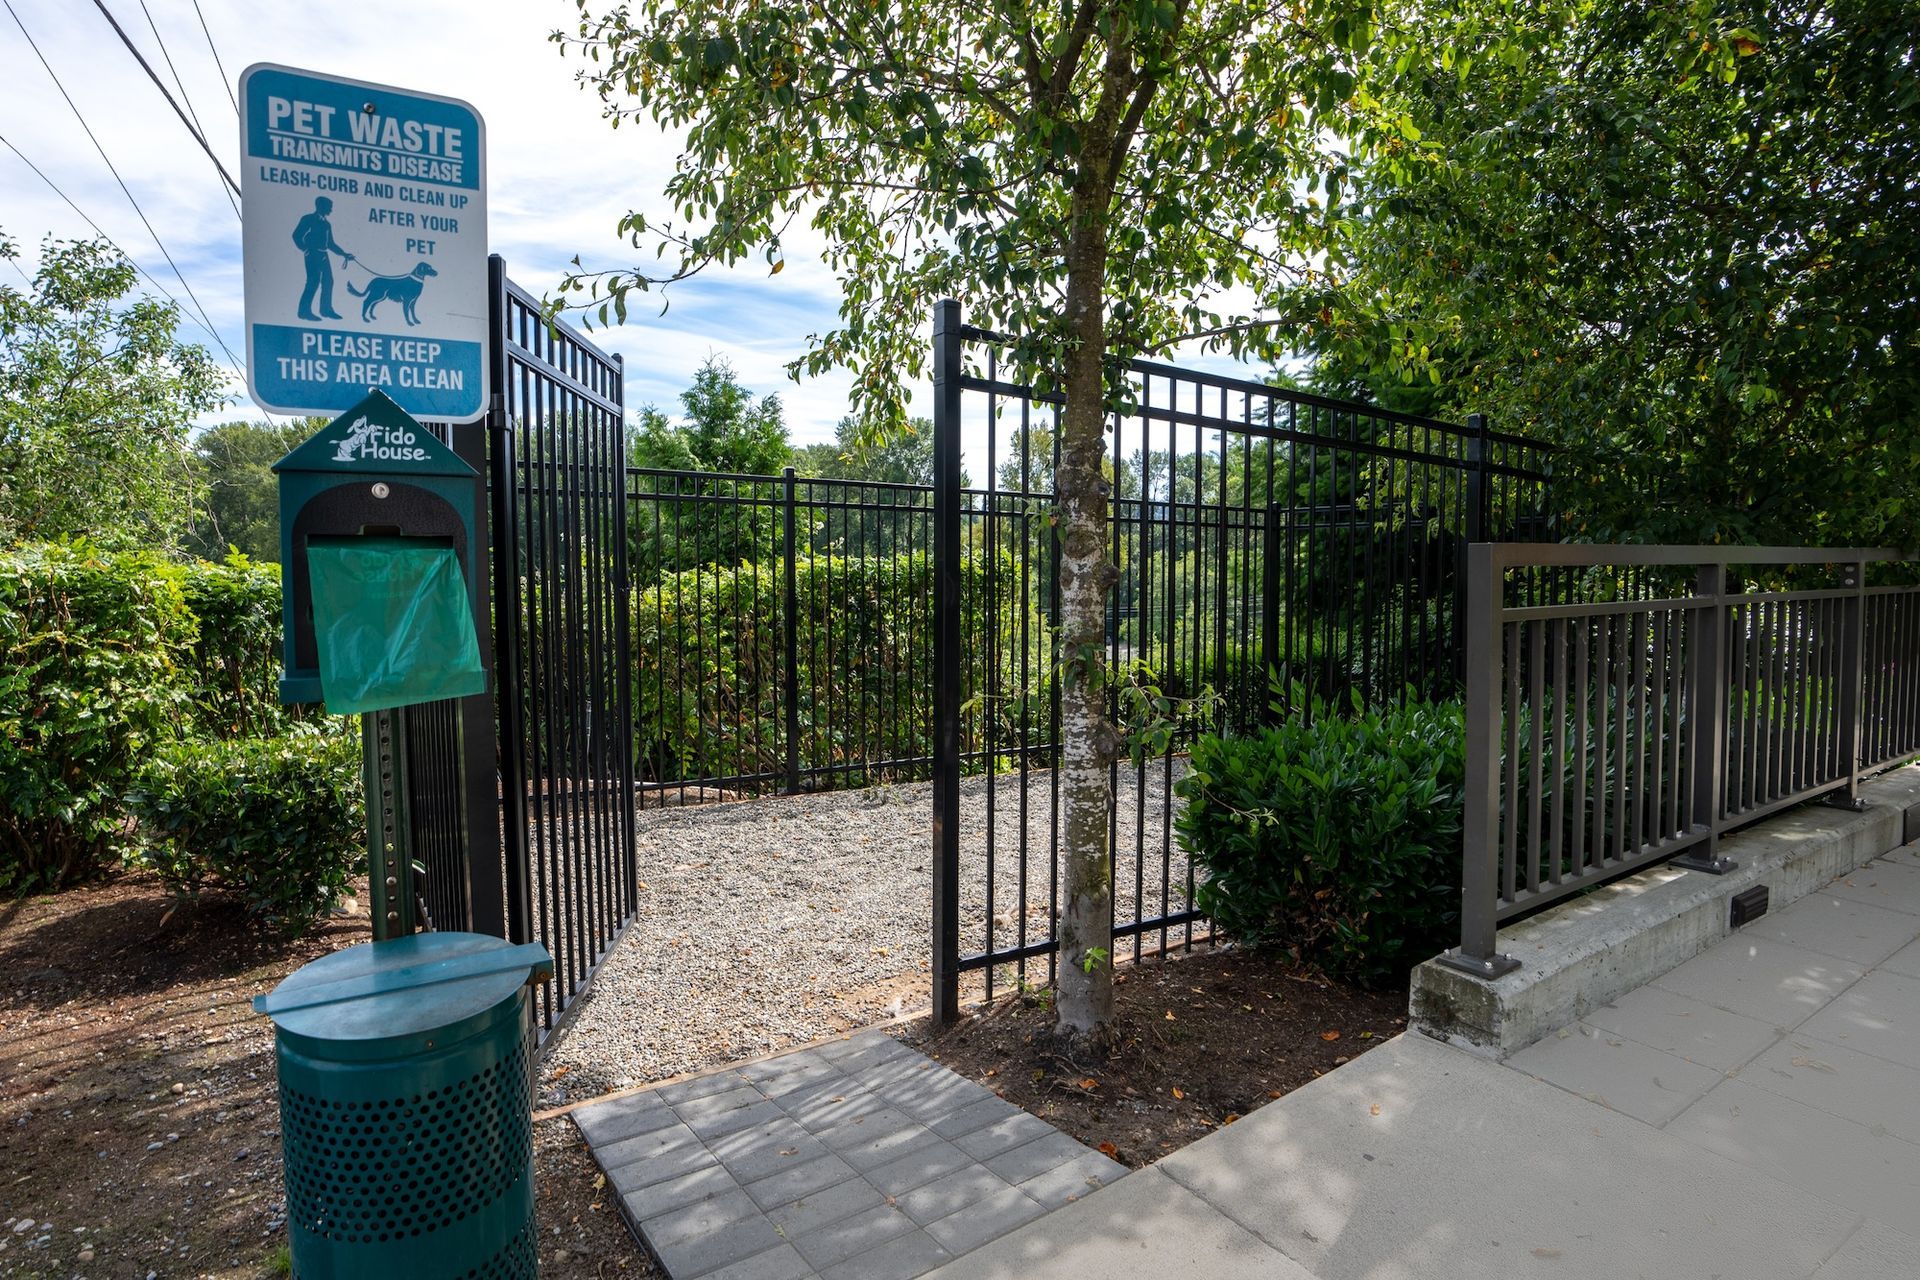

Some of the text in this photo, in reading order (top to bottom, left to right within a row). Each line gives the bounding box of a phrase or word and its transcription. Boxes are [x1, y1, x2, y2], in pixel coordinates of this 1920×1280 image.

[268, 96, 463, 159] PET WASTE
[269, 135, 463, 184] TRANSMITS DISEASE
[260, 166, 469, 210] LEASH-CURB AND CLEAN UP
[368, 208, 459, 233] AFTER YOUR
[406, 238, 436, 255] PET
[302, 333, 441, 364] PLEASE KEEP
[277, 357, 463, 391] THIS AREA CLEAN
[371, 425, 416, 445] Fido
[361, 441, 425, 461] House
